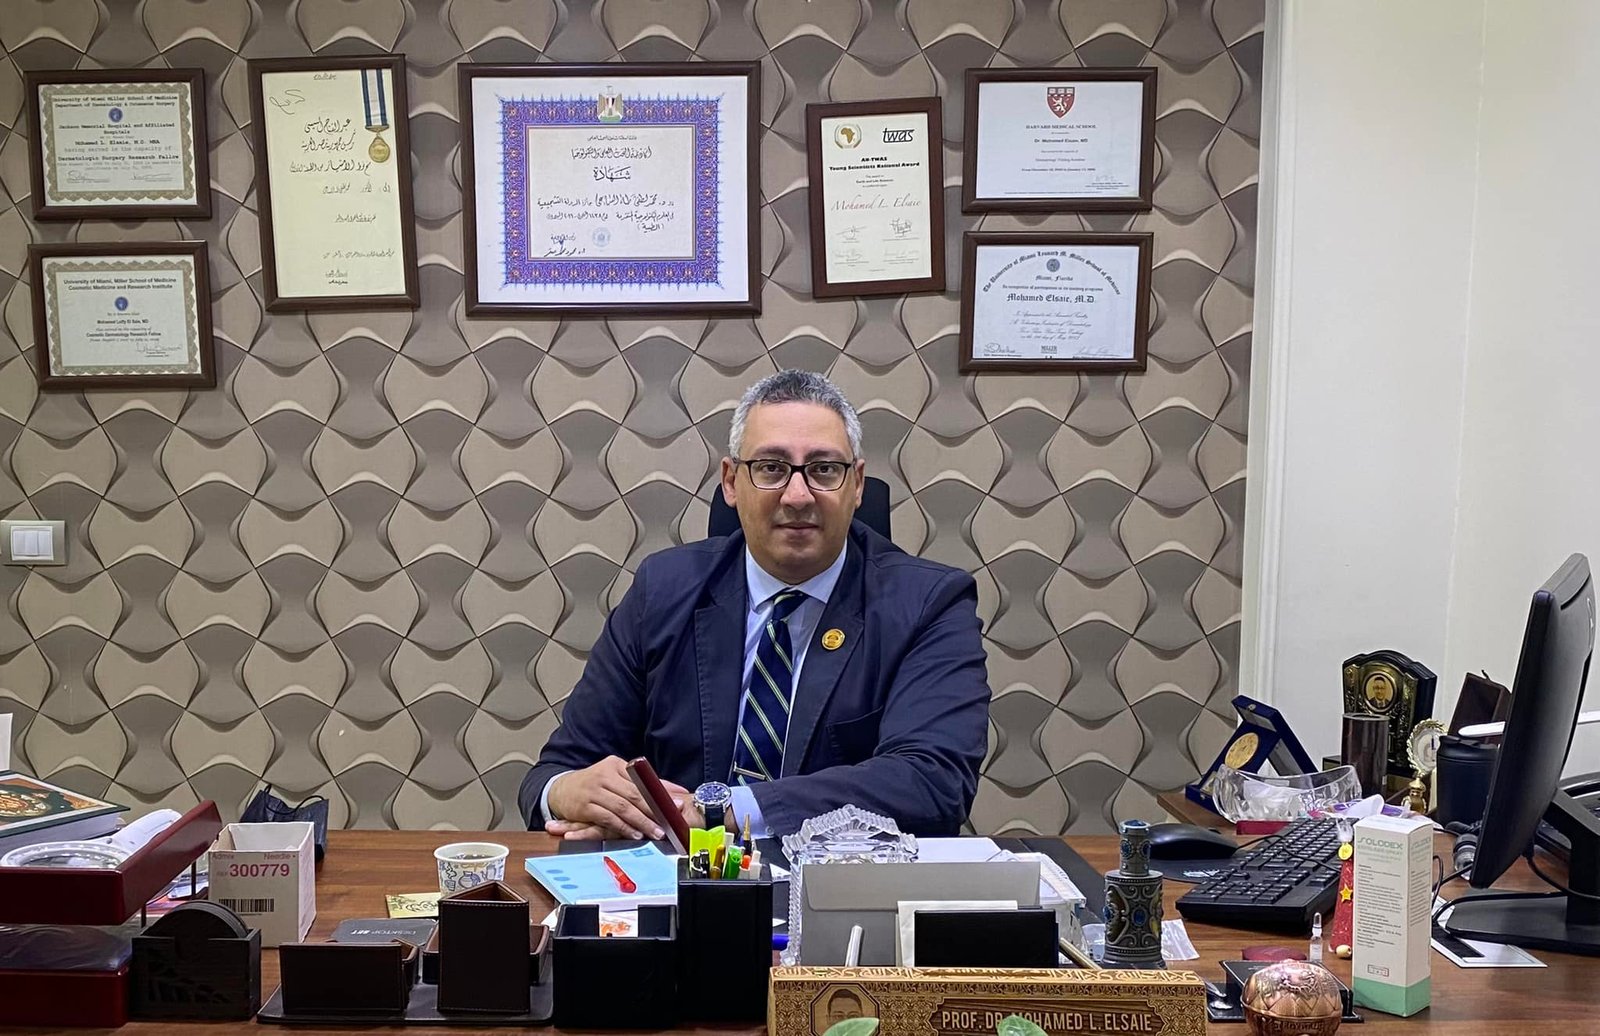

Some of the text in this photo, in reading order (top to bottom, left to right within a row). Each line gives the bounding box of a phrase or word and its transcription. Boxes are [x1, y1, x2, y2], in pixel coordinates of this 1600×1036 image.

[882, 128, 915, 143] twas
[593, 165, 632, 182] شهادة
[1006, 292, 1044, 302] Mohamed
[229, 863, 291, 877] 300779
[942, 1011, 1152, 1031] PROF. DR OHAMED L. ELSAIE
